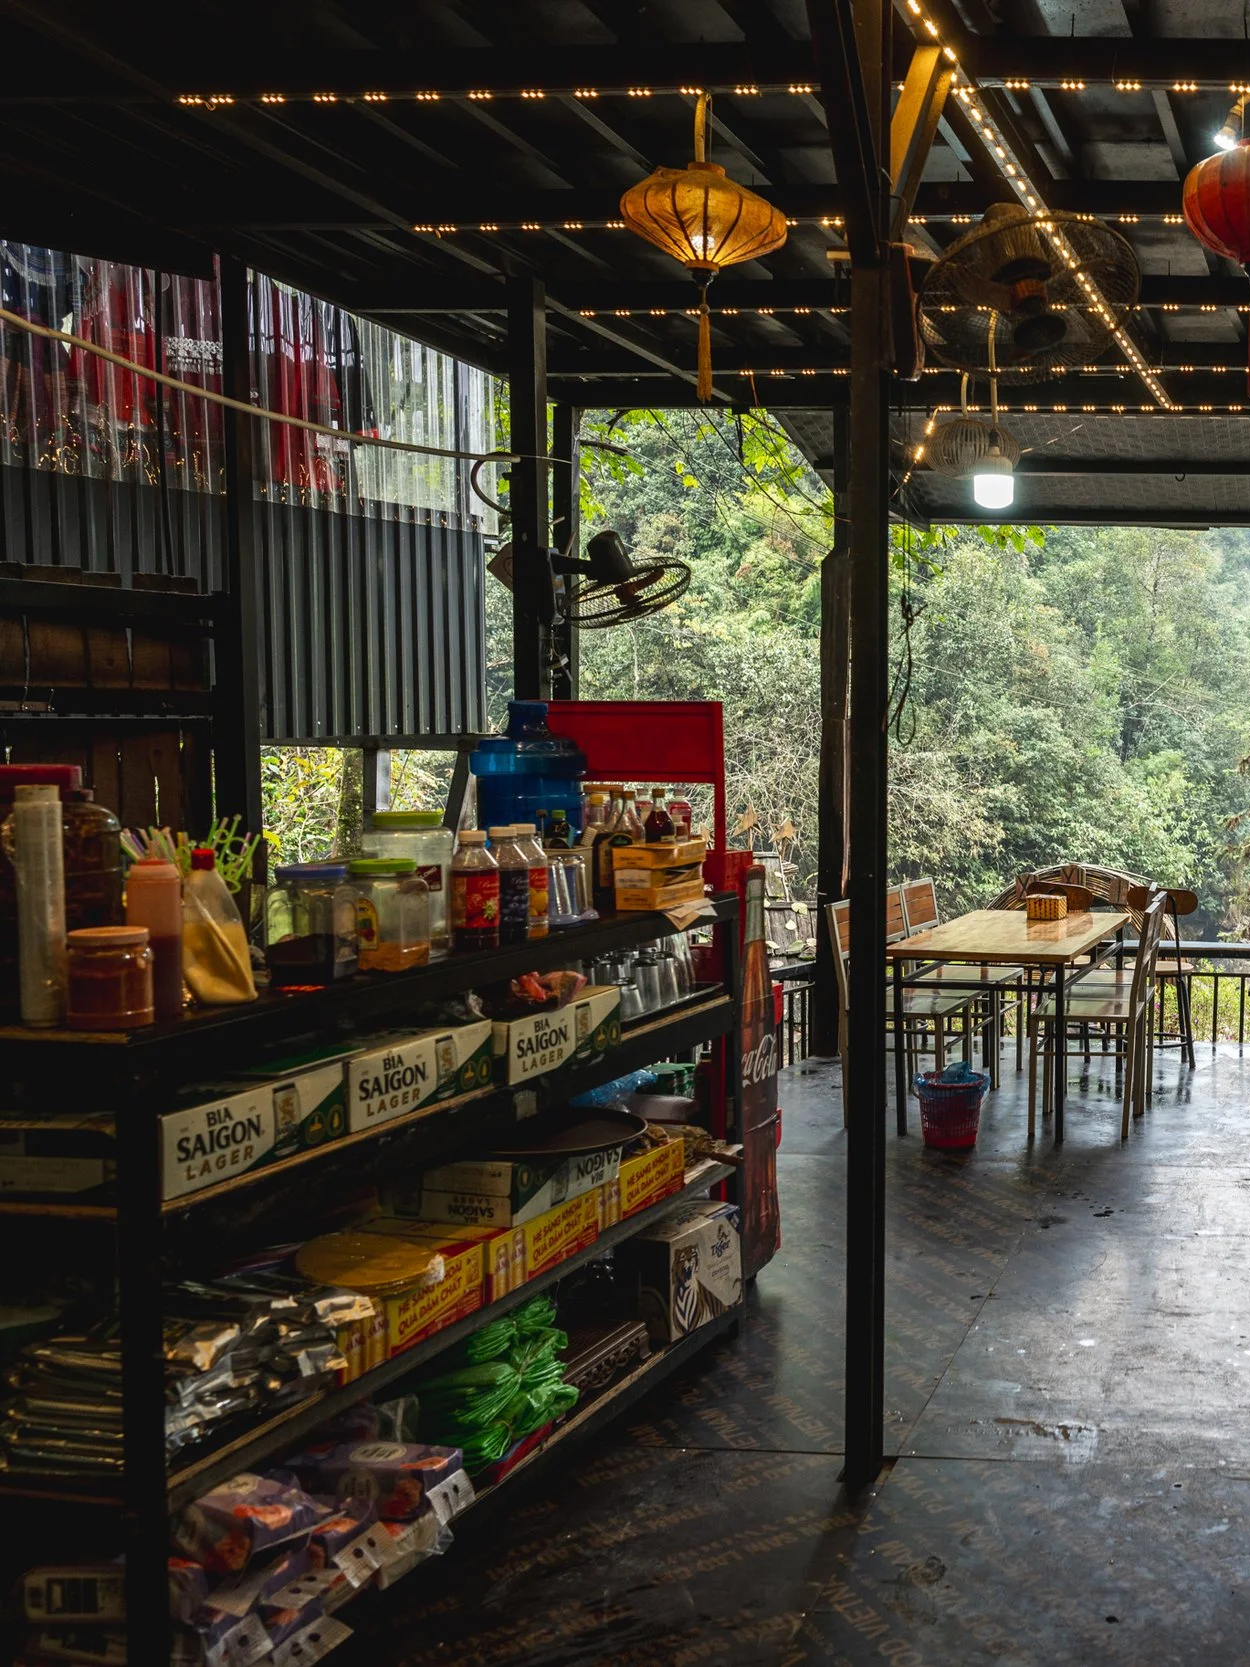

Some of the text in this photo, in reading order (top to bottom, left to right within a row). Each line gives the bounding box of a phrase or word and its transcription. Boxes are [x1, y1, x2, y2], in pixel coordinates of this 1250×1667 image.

[534, 1018, 550, 1033] BIA
[517, 1024, 568, 1059] SAIGON
[382, 1054, 405, 1072] BIA
[522, 1048, 564, 1073] LAGER
[359, 1062, 426, 1102] SAIGON
[366, 1088, 421, 1118] LAGER
[206, 1107, 233, 1128] BIA
[177, 1114, 262, 1163] SAIGON
[186, 1144, 255, 1181] LAGER
[711, 1240, 731, 1258] Tiger
